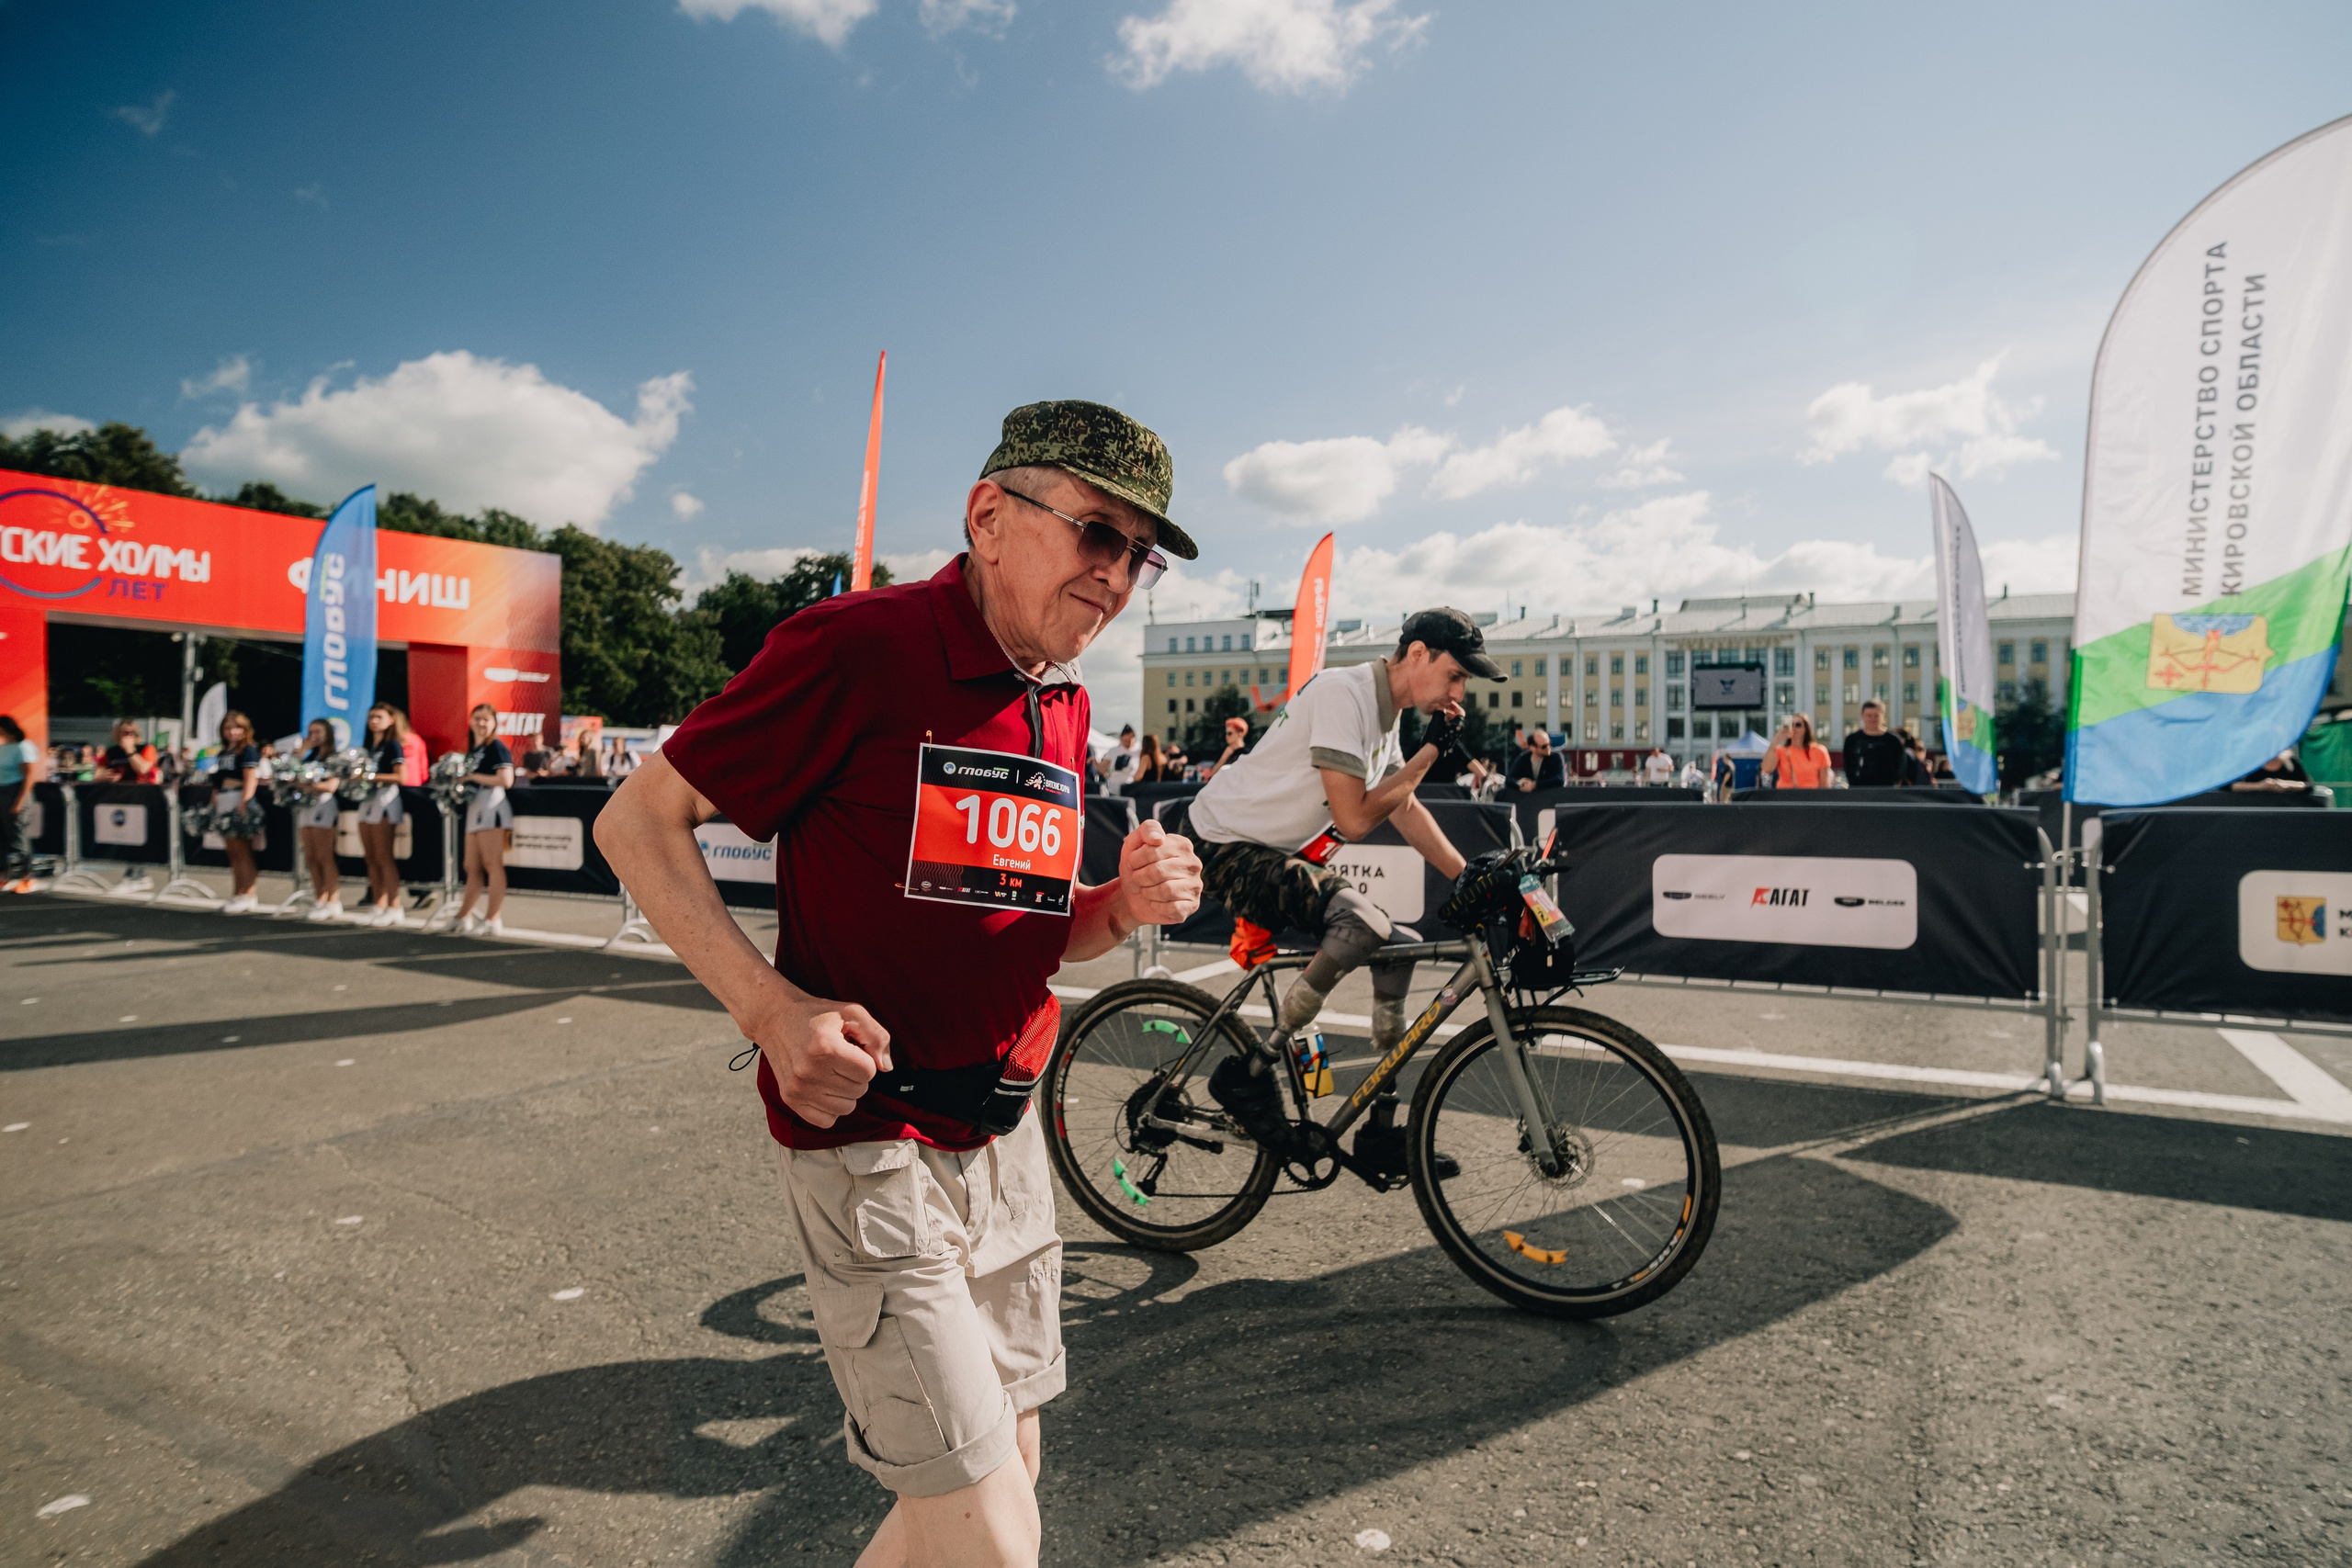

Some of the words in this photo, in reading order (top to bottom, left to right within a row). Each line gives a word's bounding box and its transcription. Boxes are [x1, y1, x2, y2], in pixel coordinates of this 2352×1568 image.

[2200, 241, 2228, 356] СПОРТА
[2236, 274, 2267, 412] ОБЛАСТИ
[2181, 366, 2221, 596] МИНИСТЕРСТВО
[2221, 423, 2256, 596] КИРОВСКОЙ
[0, 525, 92, 570] СКИЕ
[97, 537, 210, 583] ХОЛМЫ
[107, 579, 166, 601] ЛЕТ
[323, 553, 350, 711] ГЛОБУС
[957, 766, 1009, 780] ГЛОБУС
[713, 845, 772, 861] ГЛОБУС
[956, 795, 1061, 856] 1066
[992, 853, 1031, 871] Евгений
[1000, 874, 1006, 886] 3
[1770, 888, 1811, 907] АГАТ
[1352, 1000, 1442, 1108] FORWARD
